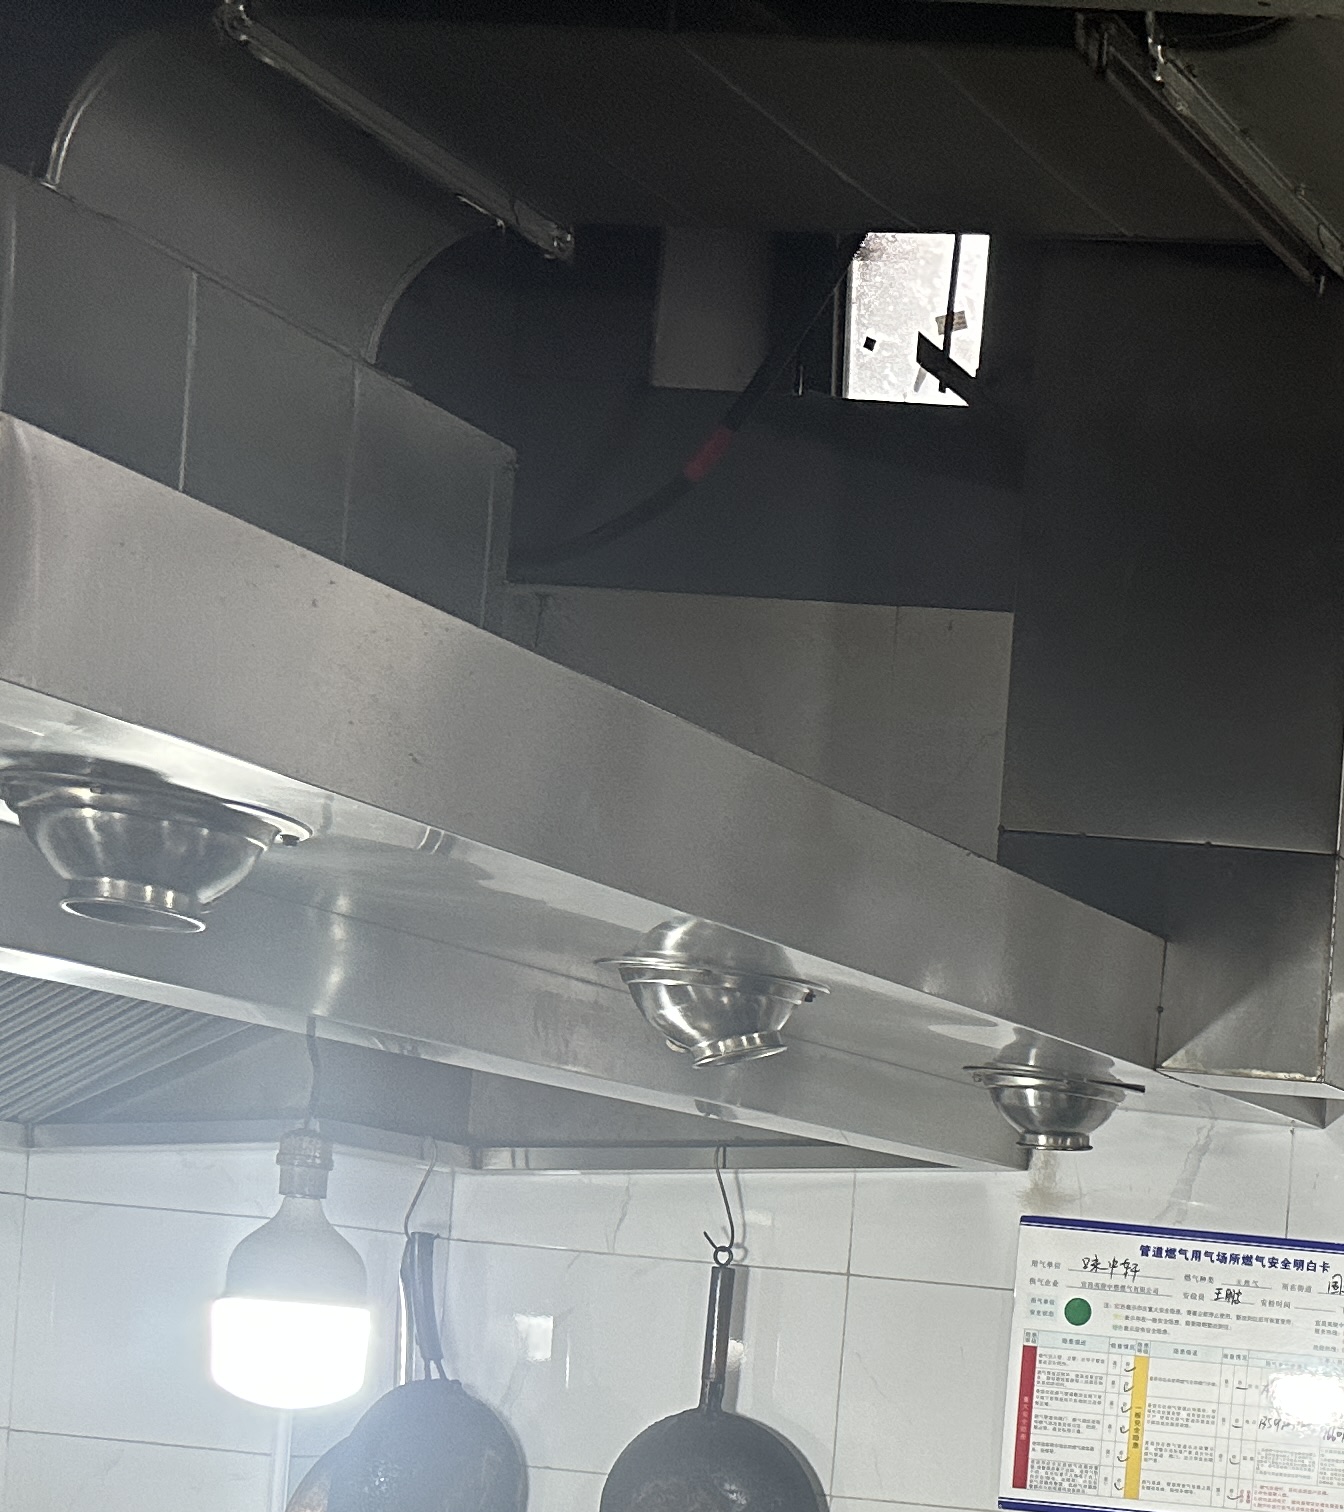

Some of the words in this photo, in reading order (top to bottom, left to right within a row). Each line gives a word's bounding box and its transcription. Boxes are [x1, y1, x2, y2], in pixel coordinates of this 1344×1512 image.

[1139, 1244, 1331, 1273] 管道燃气用气场所燃气安全明白卡
